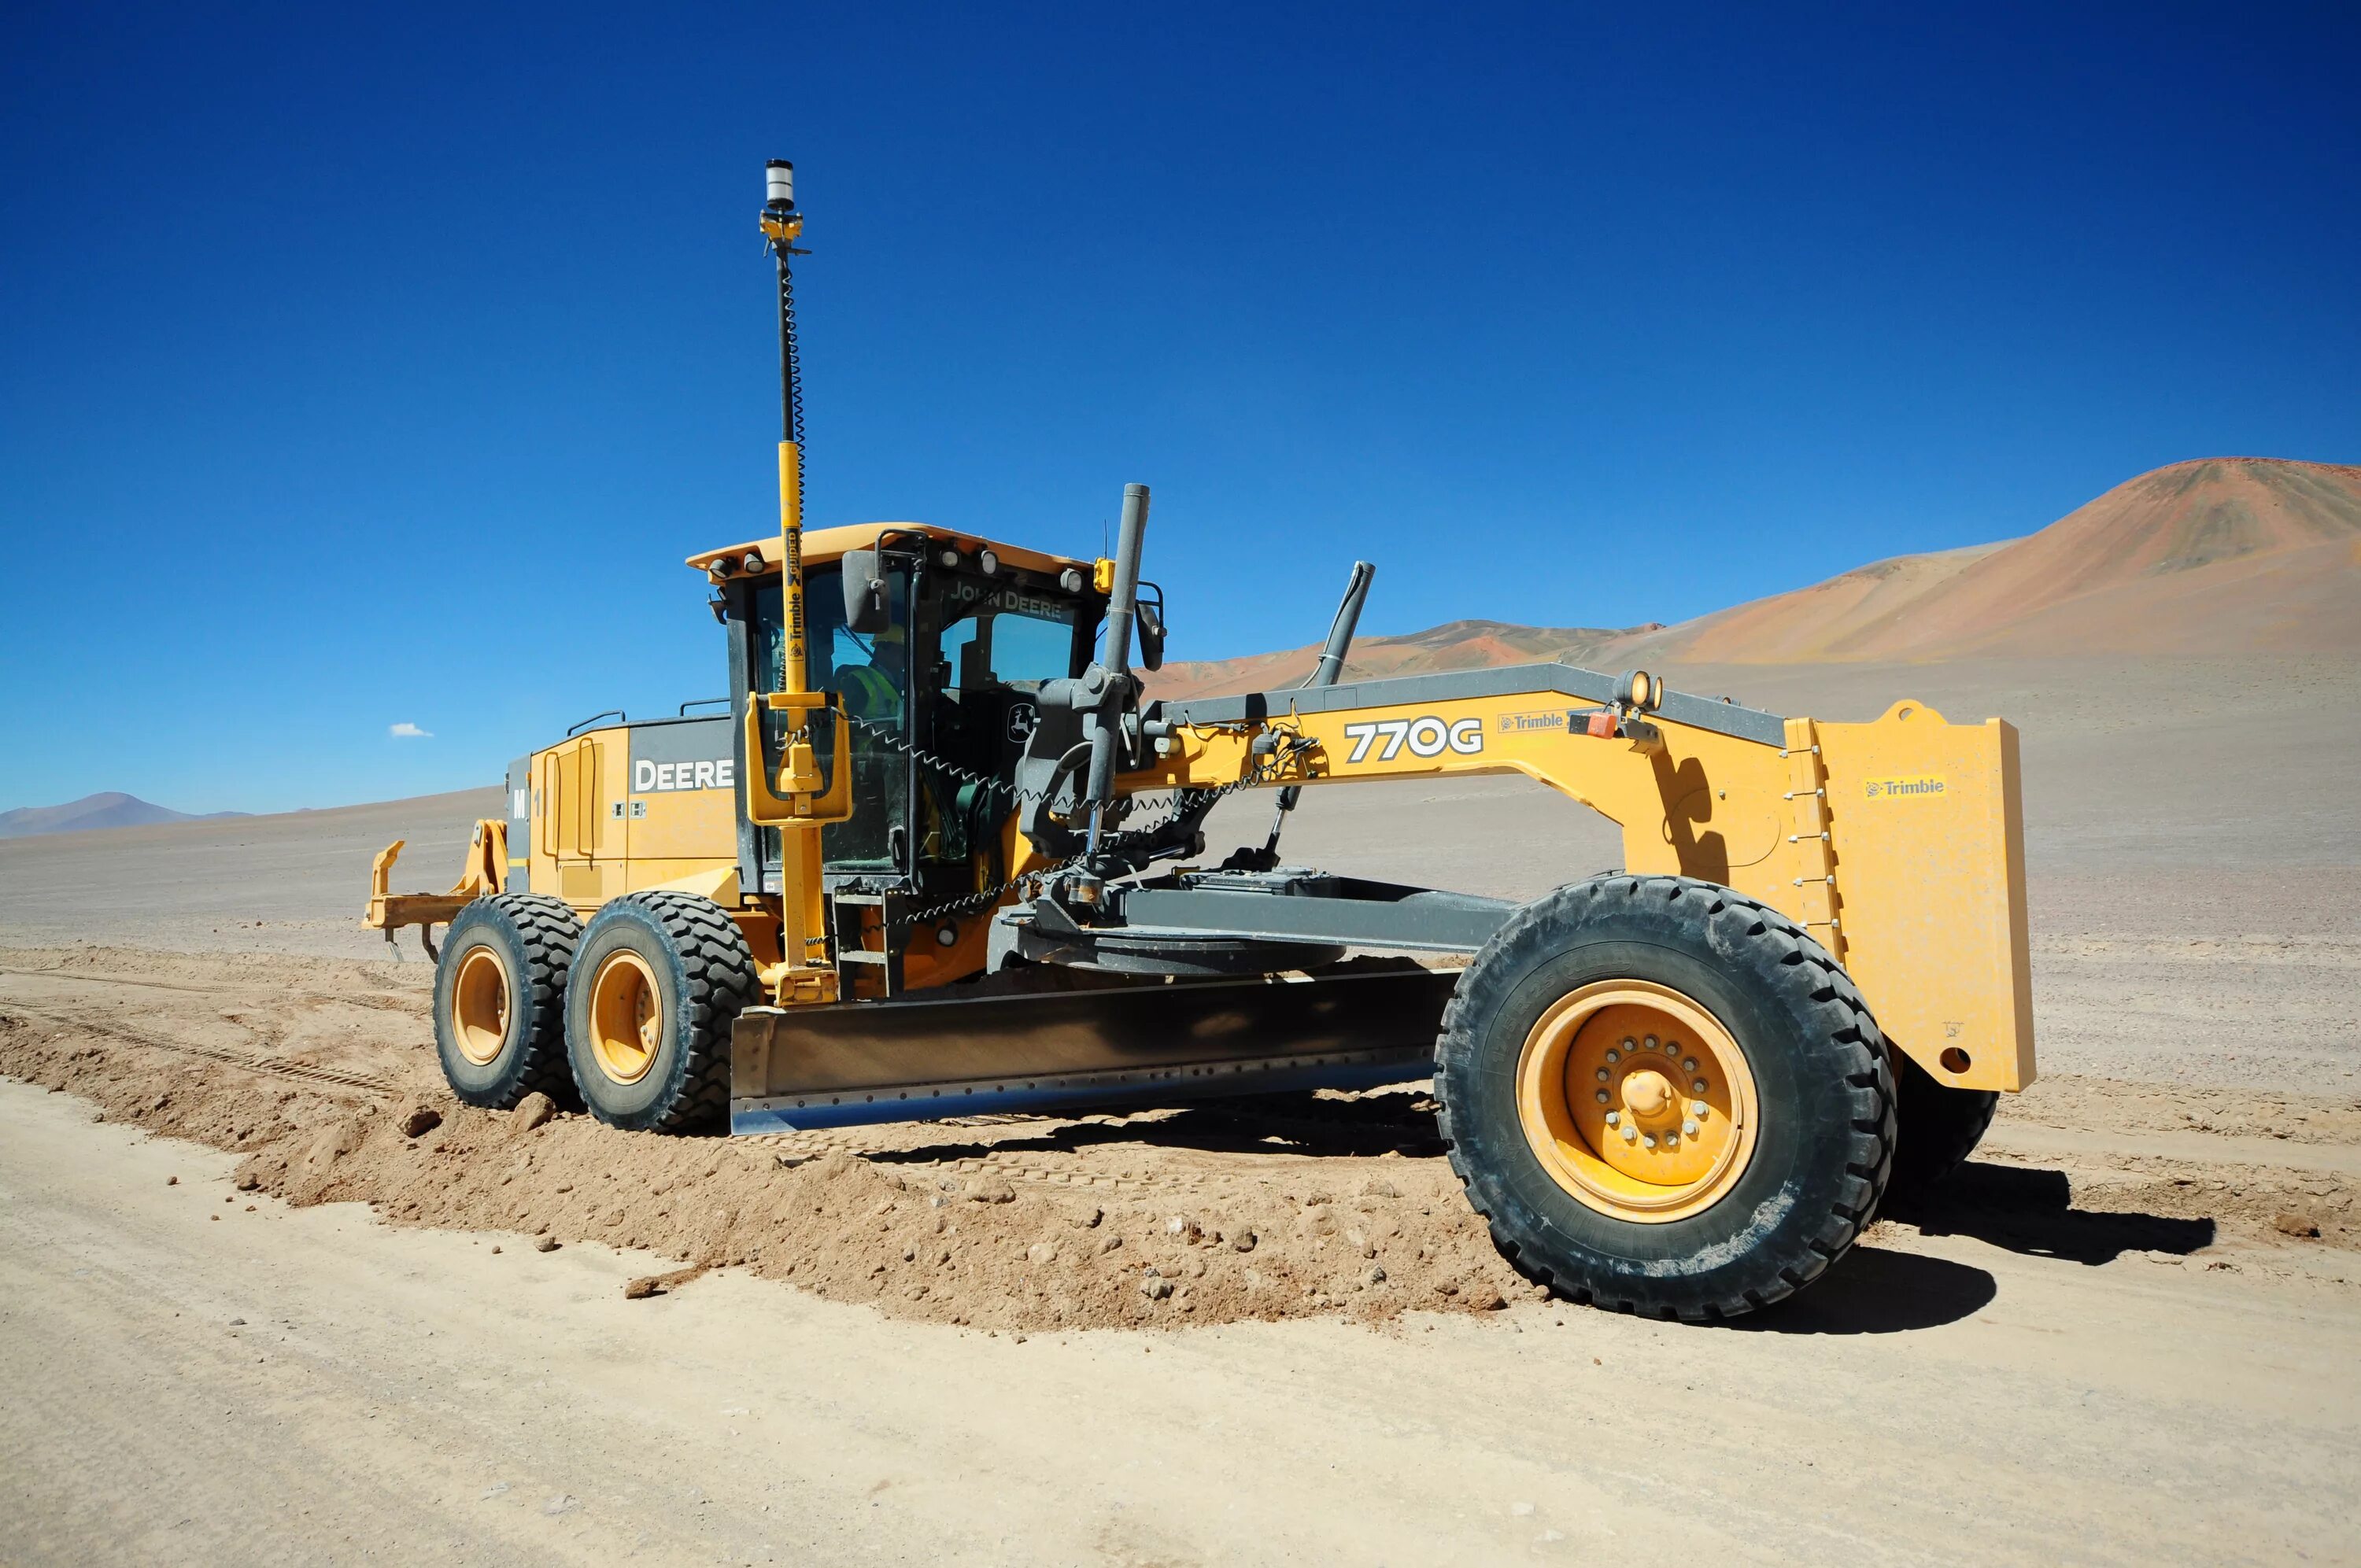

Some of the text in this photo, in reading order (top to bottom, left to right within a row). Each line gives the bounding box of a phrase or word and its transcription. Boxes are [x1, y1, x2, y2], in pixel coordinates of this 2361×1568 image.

[789, 592, 801, 641] Trimble
[1005, 591, 1062, 619] DEERE
[1514, 714, 1563, 729] Trimble
[1344, 716, 1483, 764] 770G
[635, 759, 733, 791] DEERE
[1883, 779, 1944, 795] Trimble
